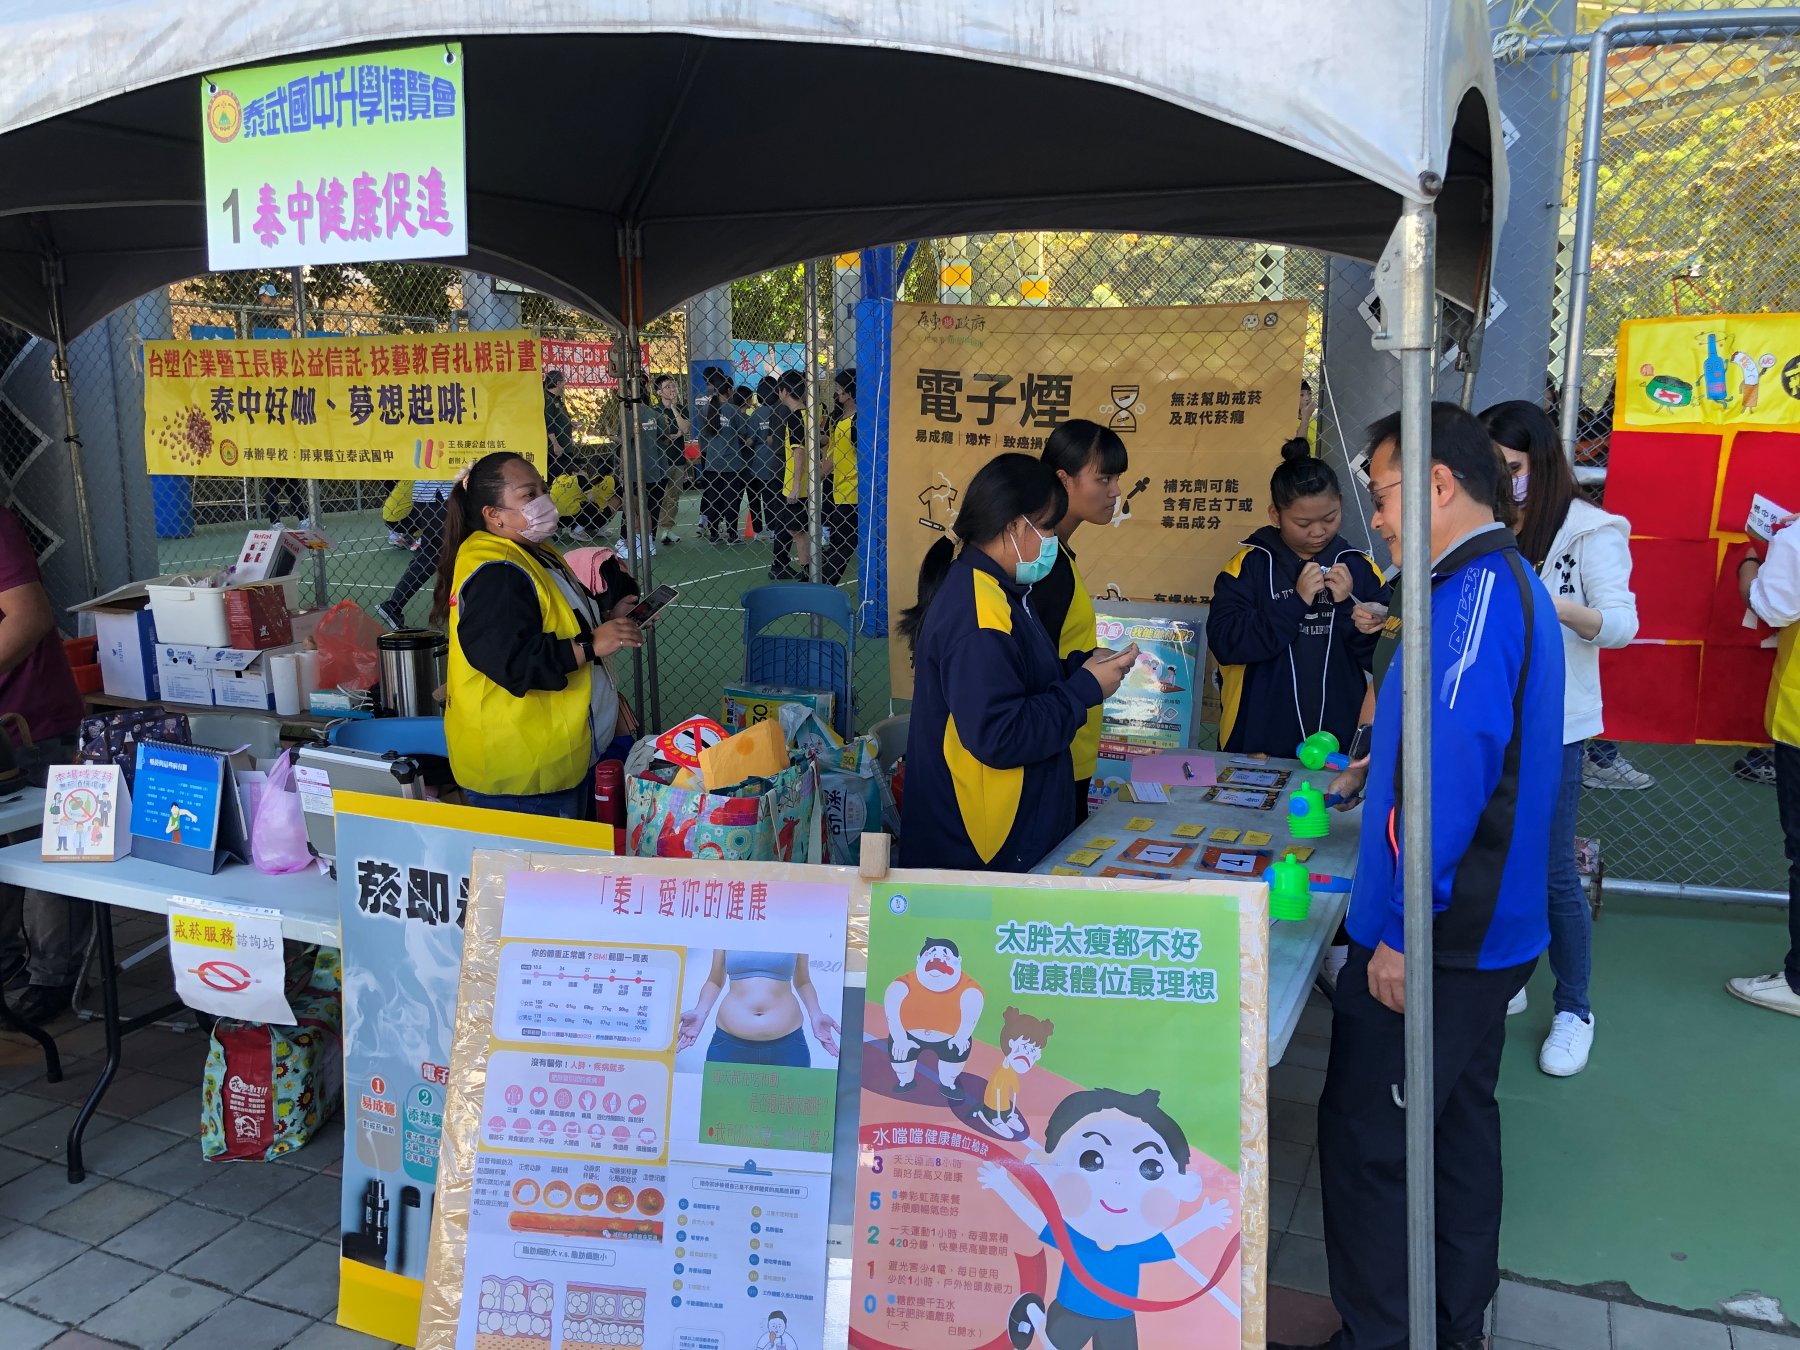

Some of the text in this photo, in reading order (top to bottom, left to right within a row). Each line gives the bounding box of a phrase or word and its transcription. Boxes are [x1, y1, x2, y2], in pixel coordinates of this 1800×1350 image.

[243, 65, 456, 138] 泰武國中升學博覽會
[222, 166, 454, 249] 1 泰中健康促進
[916, 368, 1073, 428] 電子煙
[1170, 391, 1262, 407] 無法幫助戒菸
[965, 432, 991, 447] 爆炸
[1003, 435, 1048, 450] 致癌損
[243, 445, 395, 464] 承辦學校：屏東縣立泰武國中
[1163, 479, 1239, 493] 補充劑可能
[1163, 498, 1253, 512] 含有尼古丁或
[1161, 515, 1221, 530] 毒品成分
[174, 919, 275, 951] 戒菸服務諮詢站
[997, 921, 1200, 960] 太胖太瘦都不好
[1011, 960, 1216, 1001] 健康體位最理想
[361, 1095, 396, 1117] 易成癮
[871, 1155, 884, 1174] 3
[893, 1168, 963, 1182] 頭好長高又健康
[869, 1191, 881, 1211] 5
[867, 1225, 880, 1245] 2
[867, 1260, 875, 1280] 1
[864, 1294, 877, 1314] 0
